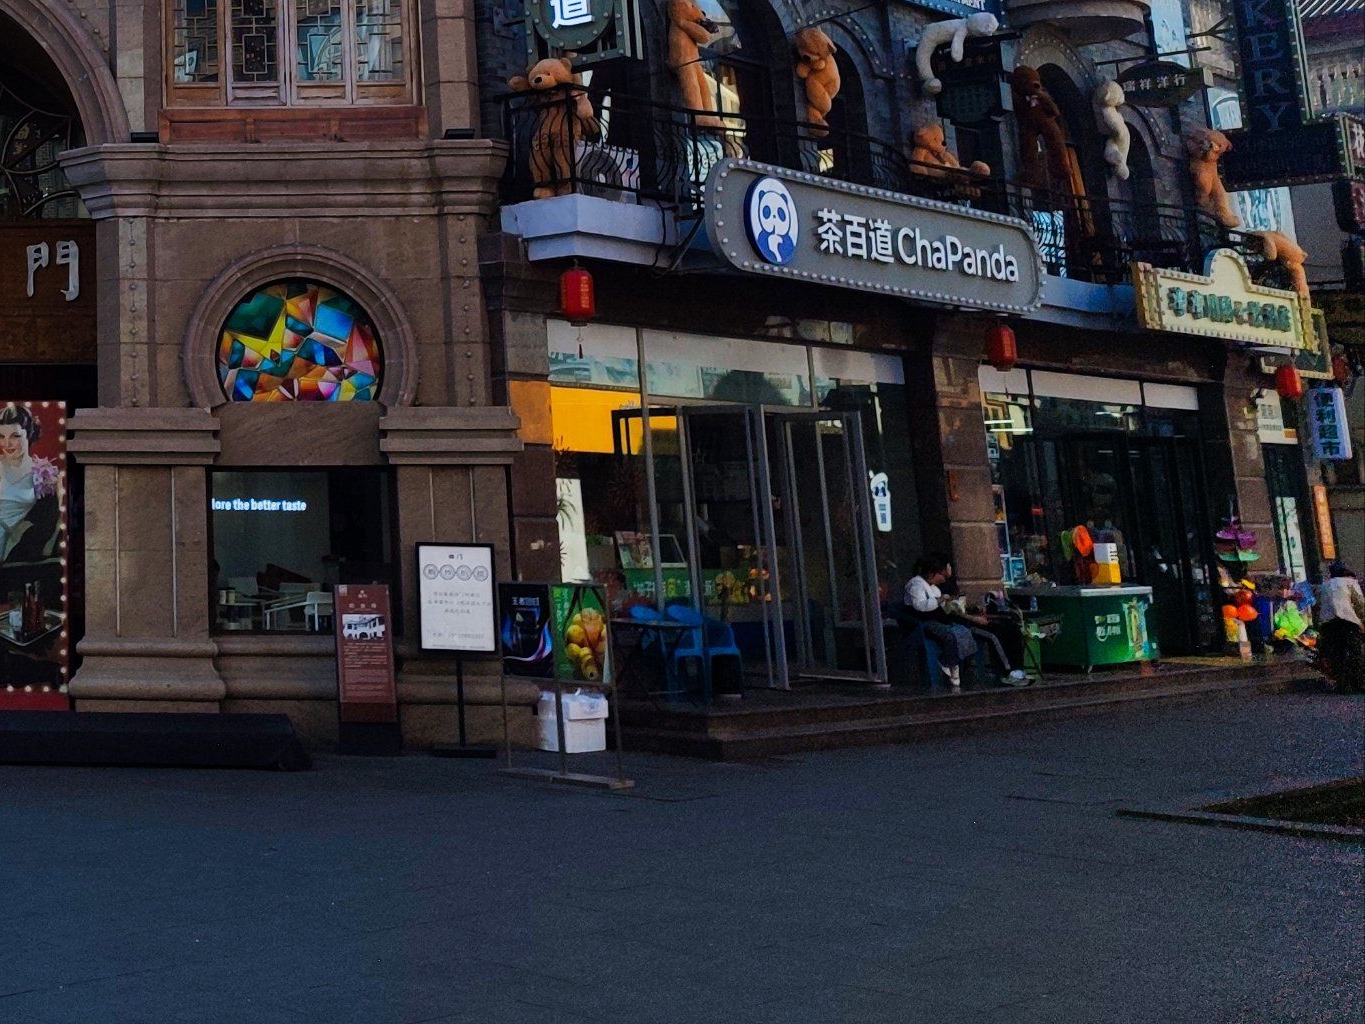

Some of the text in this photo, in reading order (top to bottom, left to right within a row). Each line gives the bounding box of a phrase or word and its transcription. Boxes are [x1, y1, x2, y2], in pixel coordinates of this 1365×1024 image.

[817, 207, 1020, 283] 茶百道 ChaPanda
[233, 497, 250, 511] the
[250, 498, 281, 511] better
[282, 499, 307, 511] taste
